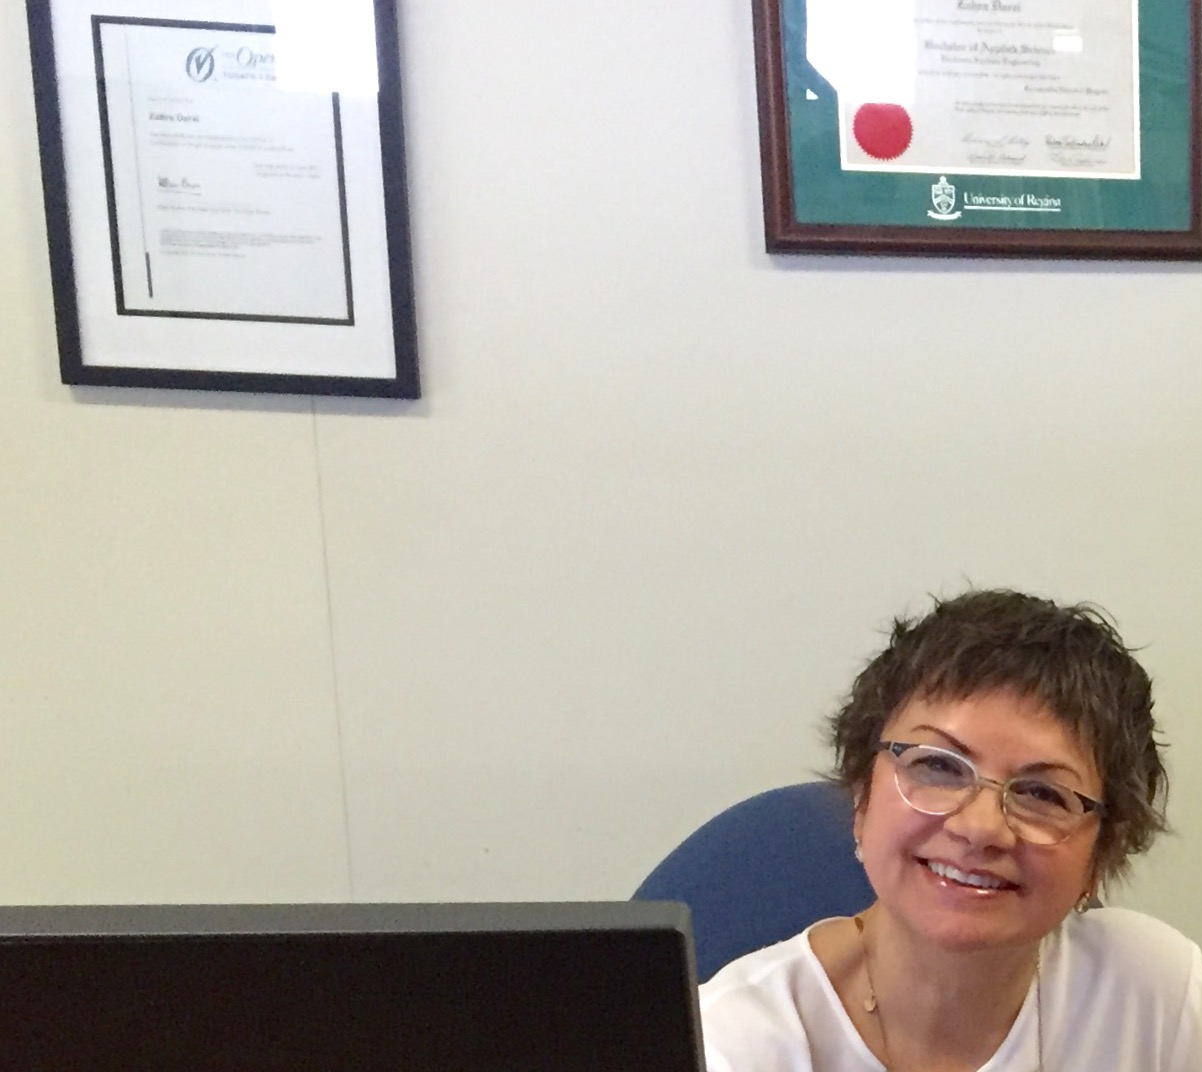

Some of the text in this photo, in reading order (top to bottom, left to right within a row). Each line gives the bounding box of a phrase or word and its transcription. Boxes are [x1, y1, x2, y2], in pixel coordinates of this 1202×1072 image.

[963, 191, 1062, 209] University of Regina
